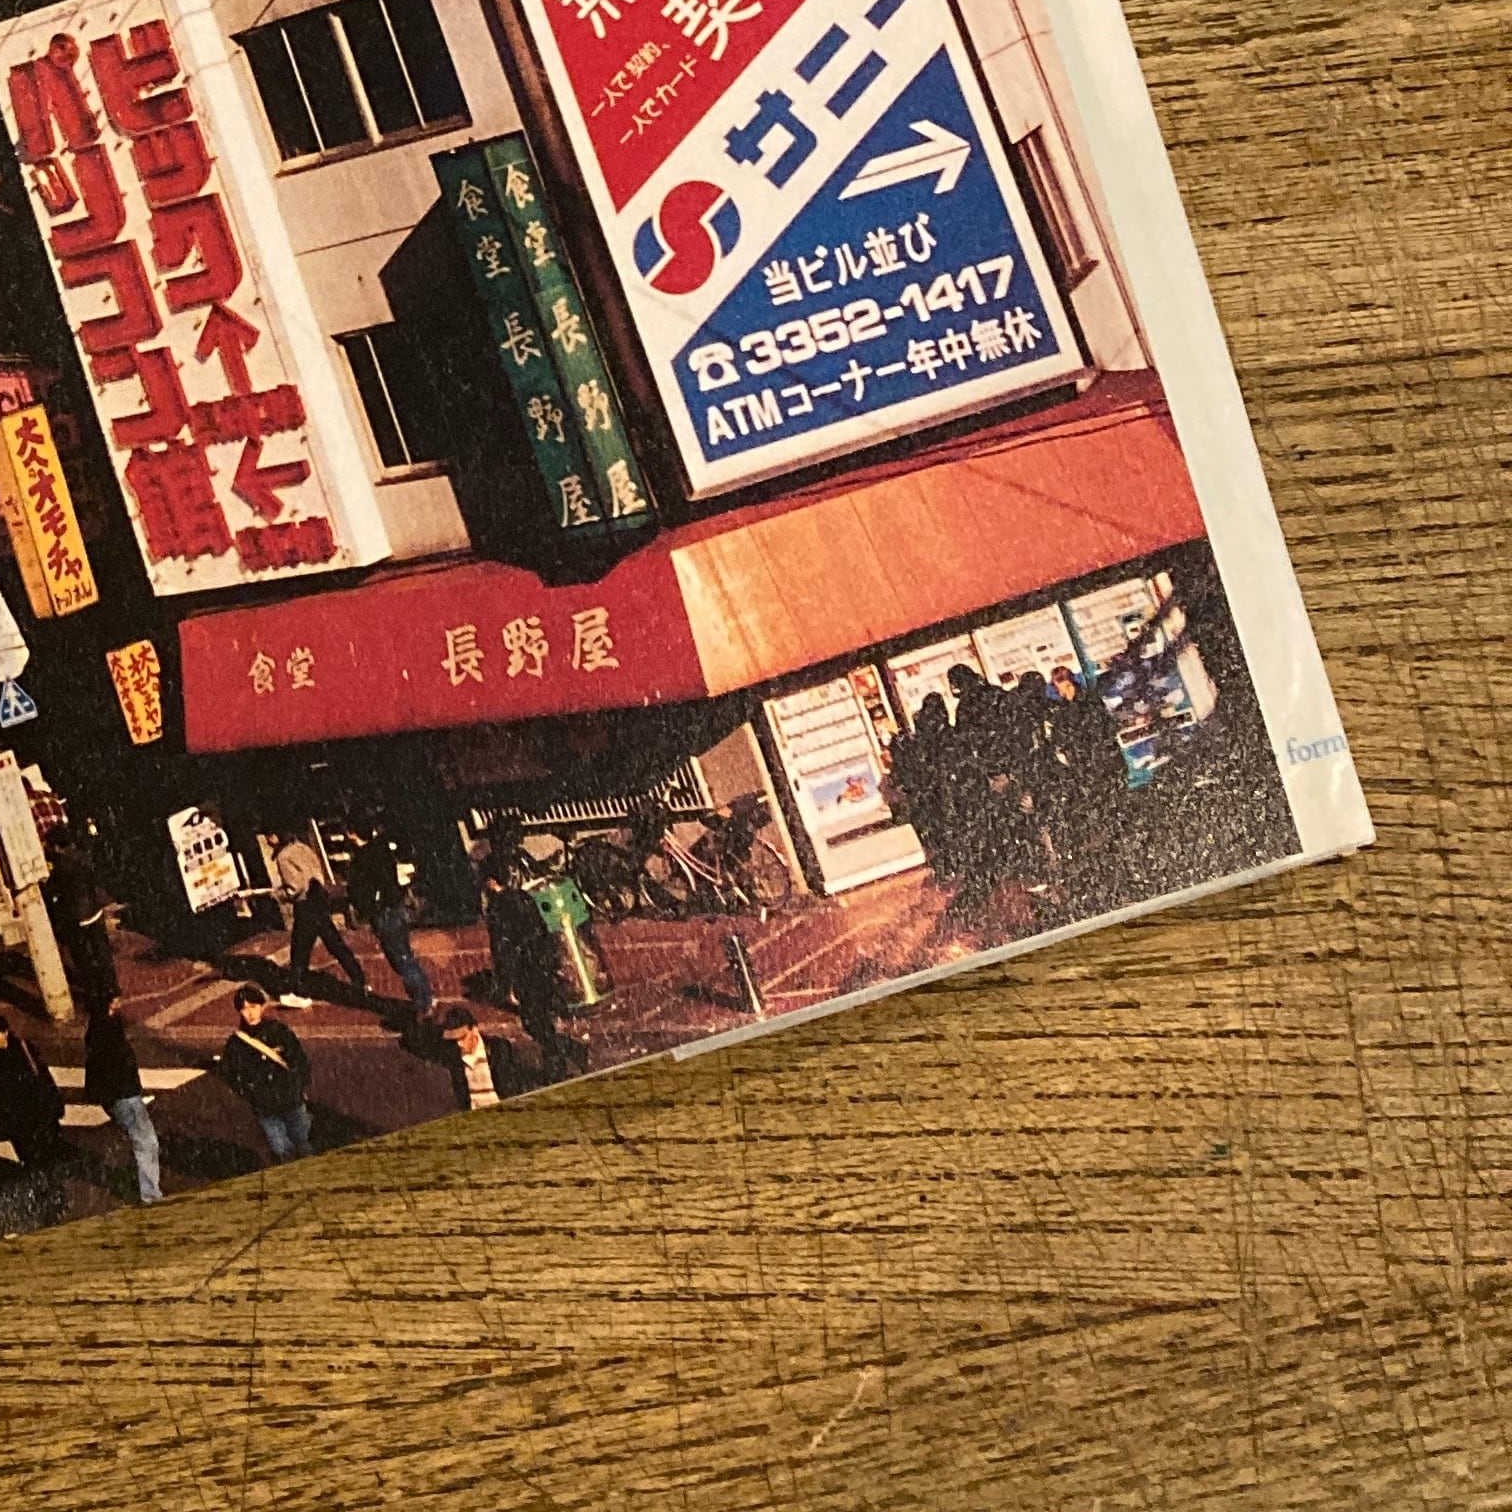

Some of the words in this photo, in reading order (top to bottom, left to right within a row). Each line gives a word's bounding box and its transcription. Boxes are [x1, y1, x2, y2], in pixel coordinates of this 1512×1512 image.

[89, 19, 244, 312] ビック
[763, 212, 938, 306] 当ビル並び
[739, 255, 1015, 375] 3352-1417
[247, 646, 318, 695] 食堂
[440, 606, 620, 688] 長野屋
